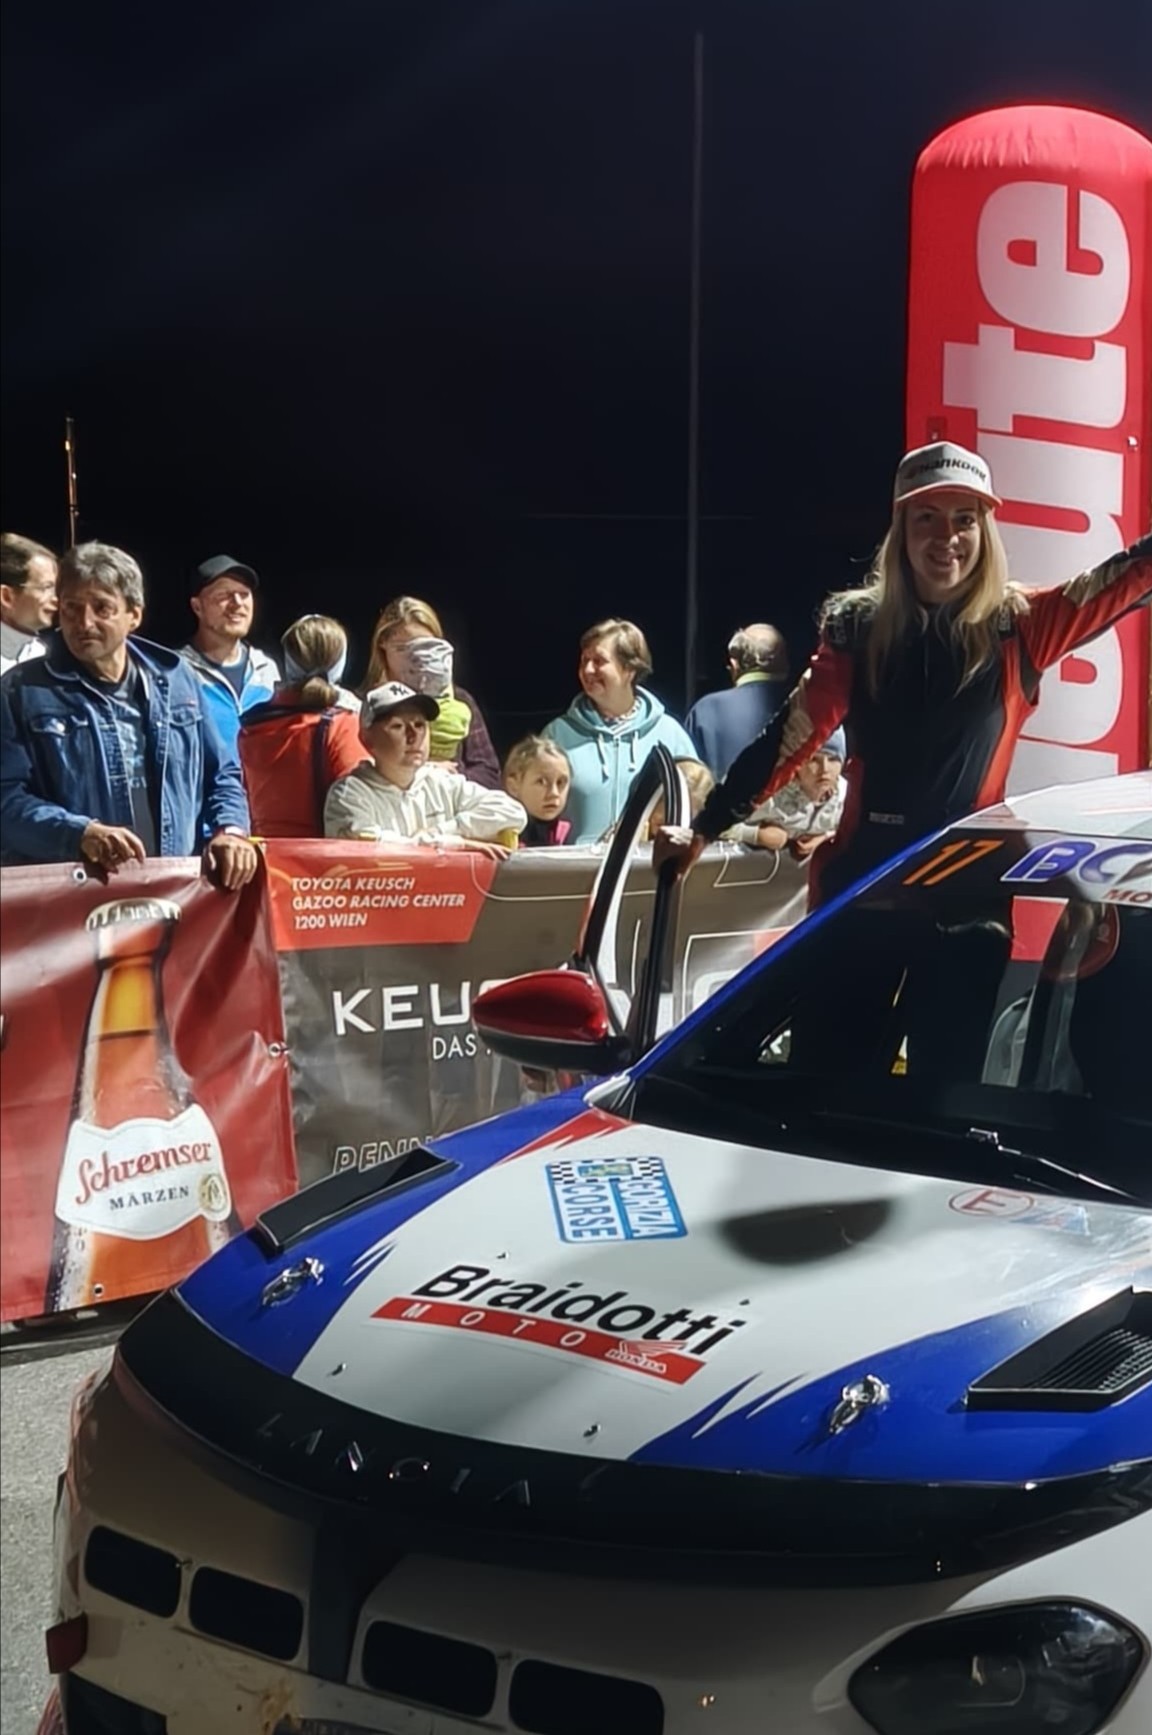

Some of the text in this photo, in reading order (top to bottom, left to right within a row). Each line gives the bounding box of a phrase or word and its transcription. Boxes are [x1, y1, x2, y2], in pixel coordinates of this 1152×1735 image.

[291, 877, 416, 892] TOYOTA KEUSCH
[902, 839, 1005, 886] 17
[292, 894, 465, 910] GAZOO RACING CENTER
[294, 913, 368, 930] 1200 WIEN
[333, 978, 510, 1036] KEU
[432, 1033, 478, 1060] DAS
[75, 1142, 212, 1205] Schremser
[110, 1185, 189, 1211] MÄRZEN
[562, 1184, 617, 1238] CORSE
[617, 1179, 678, 1238] GORIZIA
[411, 1265, 747, 1356] Braidotti
[401, 1303, 667, 1374] MOTO HONDA
